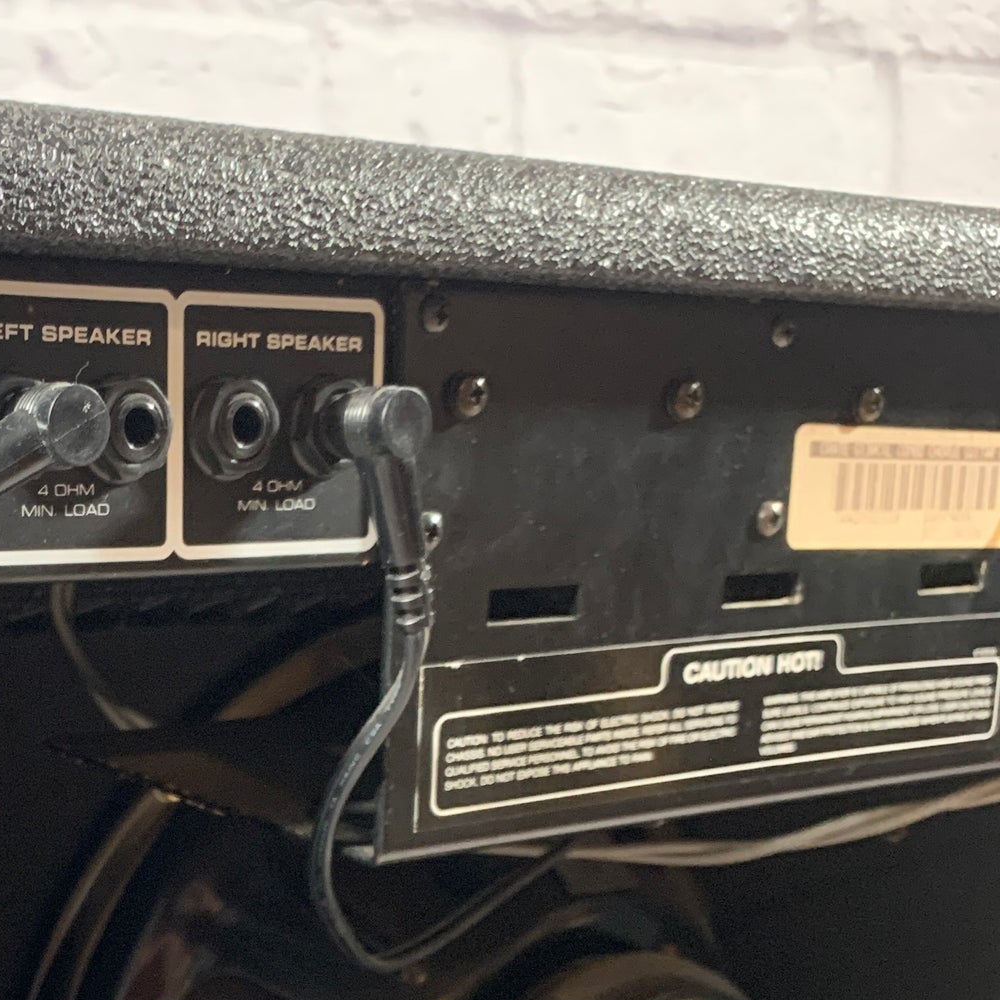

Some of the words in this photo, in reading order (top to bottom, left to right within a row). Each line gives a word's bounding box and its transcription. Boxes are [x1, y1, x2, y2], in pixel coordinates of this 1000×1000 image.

[41, 325, 152, 346] SPEAKER
[196, 330, 261, 349] RIGHT
[266, 333, 363, 353] SPEAKER
[37, 484, 49, 496] 4
[54, 483, 95, 497] OHM
[252, 480, 263, 492] 4
[267, 479, 303, 493] OHM
[64, 503, 110, 517] LOAD
[275, 497, 316, 512] LOAD
[683, 653, 775, 685] CAUTION
